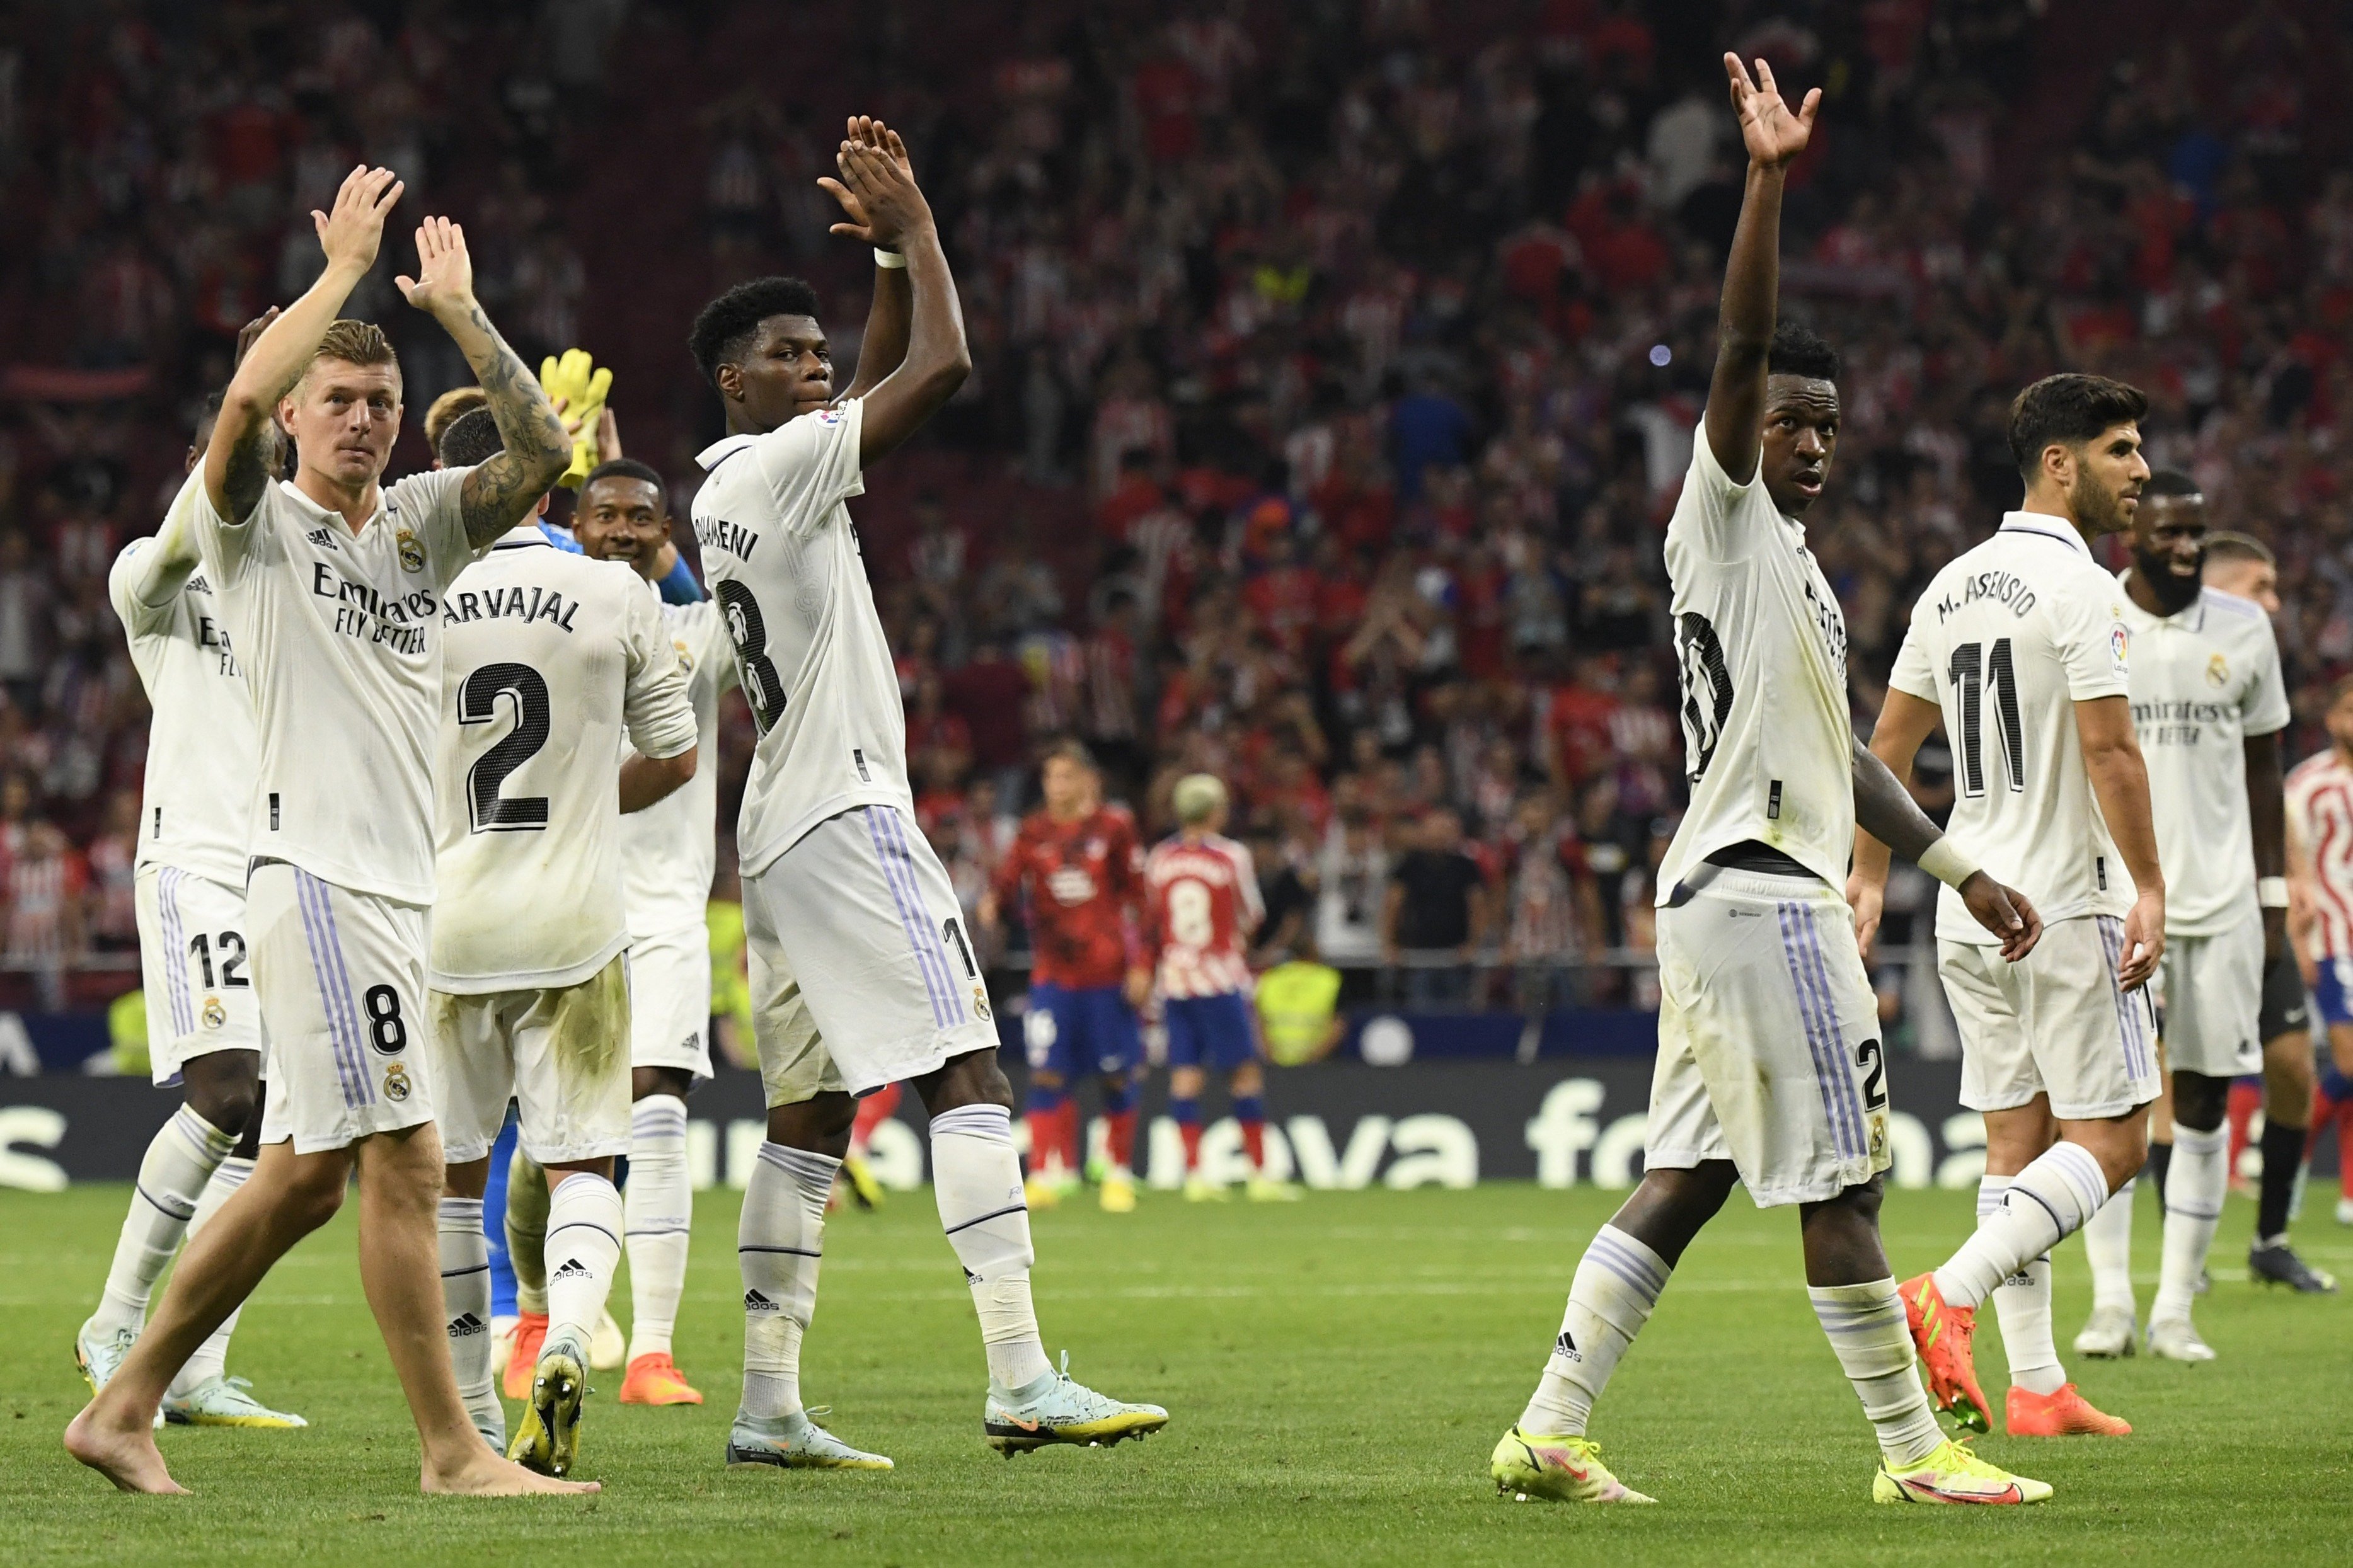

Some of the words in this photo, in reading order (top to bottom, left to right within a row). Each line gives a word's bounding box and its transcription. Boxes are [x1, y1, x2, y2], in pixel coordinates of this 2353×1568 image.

[695, 515, 759, 563] OUAMENI
[443, 587, 579, 634] ARVAJAL
[1964, 570, 2036, 619] ASENSIO
[335, 608, 368, 638] FLY
[372, 621, 426, 655] BETTER
[220, 653, 242, 677] FL
[1947, 638, 2023, 798] 11
[2131, 697, 2219, 723] mirates
[457, 662, 550, 835] 2
[188, 930, 250, 992] 12
[941, 917, 977, 980] 1
[363, 984, 406, 1055] 8
[549, 1268, 593, 1286] adidas
